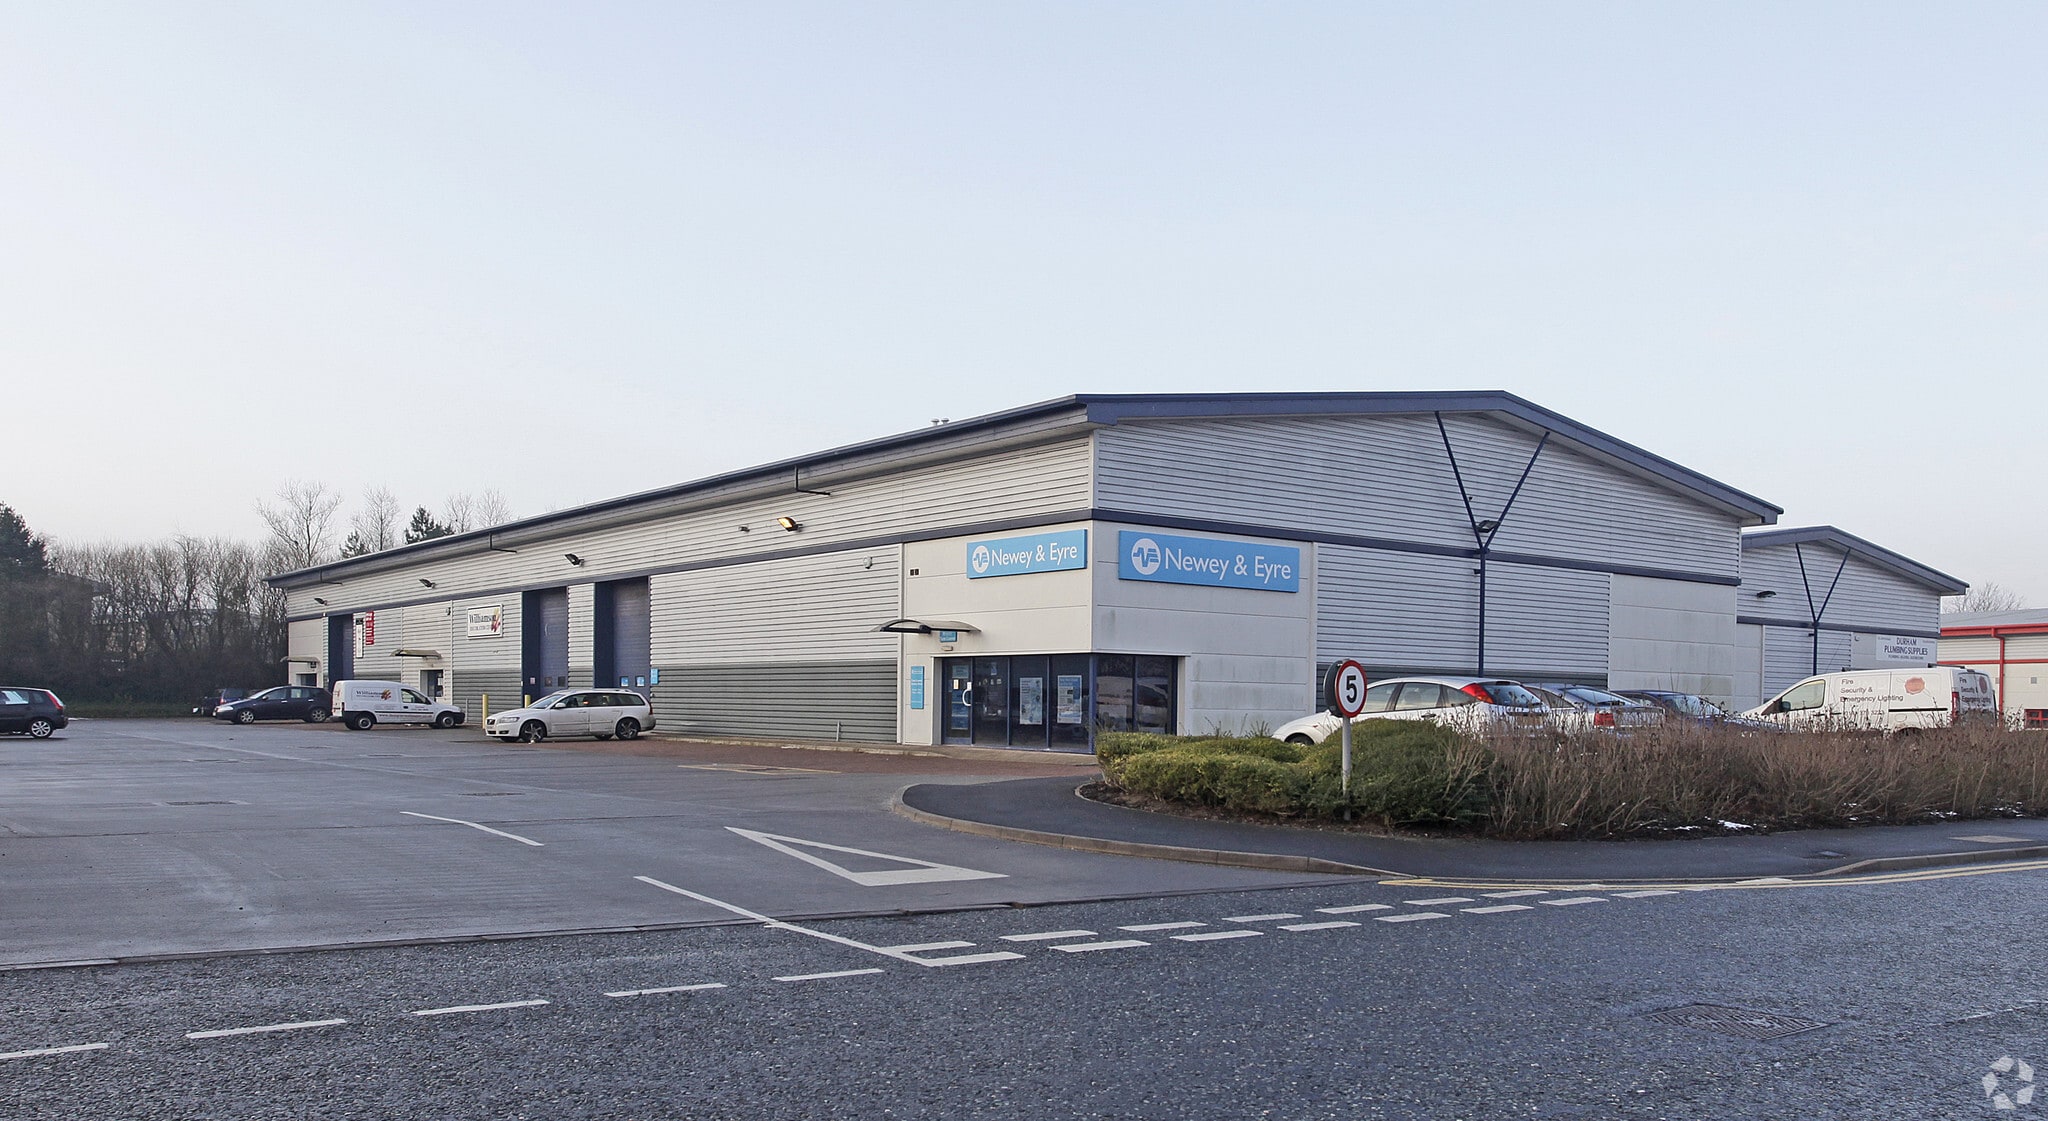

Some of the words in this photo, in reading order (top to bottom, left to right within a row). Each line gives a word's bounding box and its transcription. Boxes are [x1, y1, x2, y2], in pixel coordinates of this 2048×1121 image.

[992, 549, 1033, 569] Newey
[1035, 544, 1046, 563] &
[1050, 542, 1078, 566] Eyre
[1165, 547, 1230, 581] Newey
[1234, 554, 1248, 576] &
[1254, 555, 1292, 585] Eyre
[1896, 637, 1918, 646] DURHAM
[1884, 645, 1908, 655] PLUMBING
[1908, 646, 1929, 656] SUPPLIES
[1346, 675, 1358, 704] 5
[1840, 687, 1867, 695] Security
[1840, 695, 1876, 703] Emergency
[1877, 694, 1904, 702] Lighting
